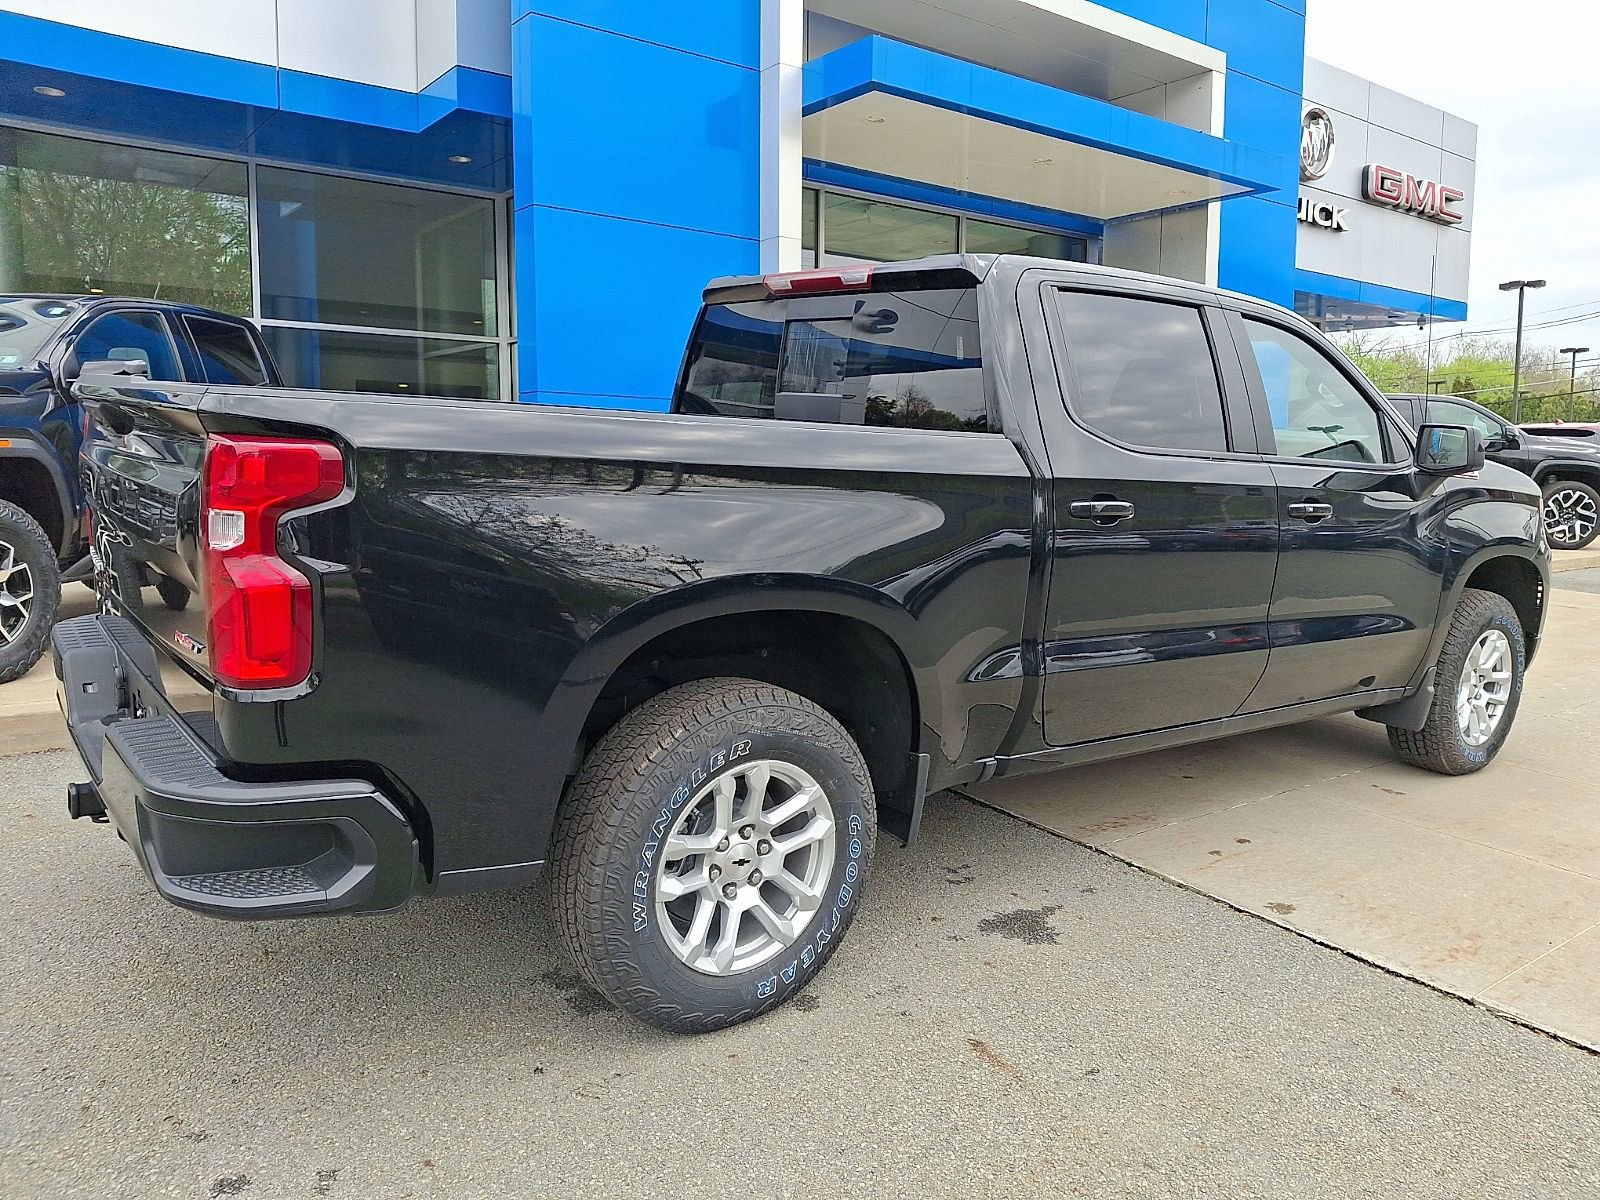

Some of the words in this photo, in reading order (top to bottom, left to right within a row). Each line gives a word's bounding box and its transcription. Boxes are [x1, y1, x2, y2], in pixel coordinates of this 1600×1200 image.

[1297, 197, 1351, 232] UICK
[1370, 163, 1465, 224] GMC
[632, 739, 752, 932] WRANGLER
[757, 814, 863, 1000] GOODYEAR
